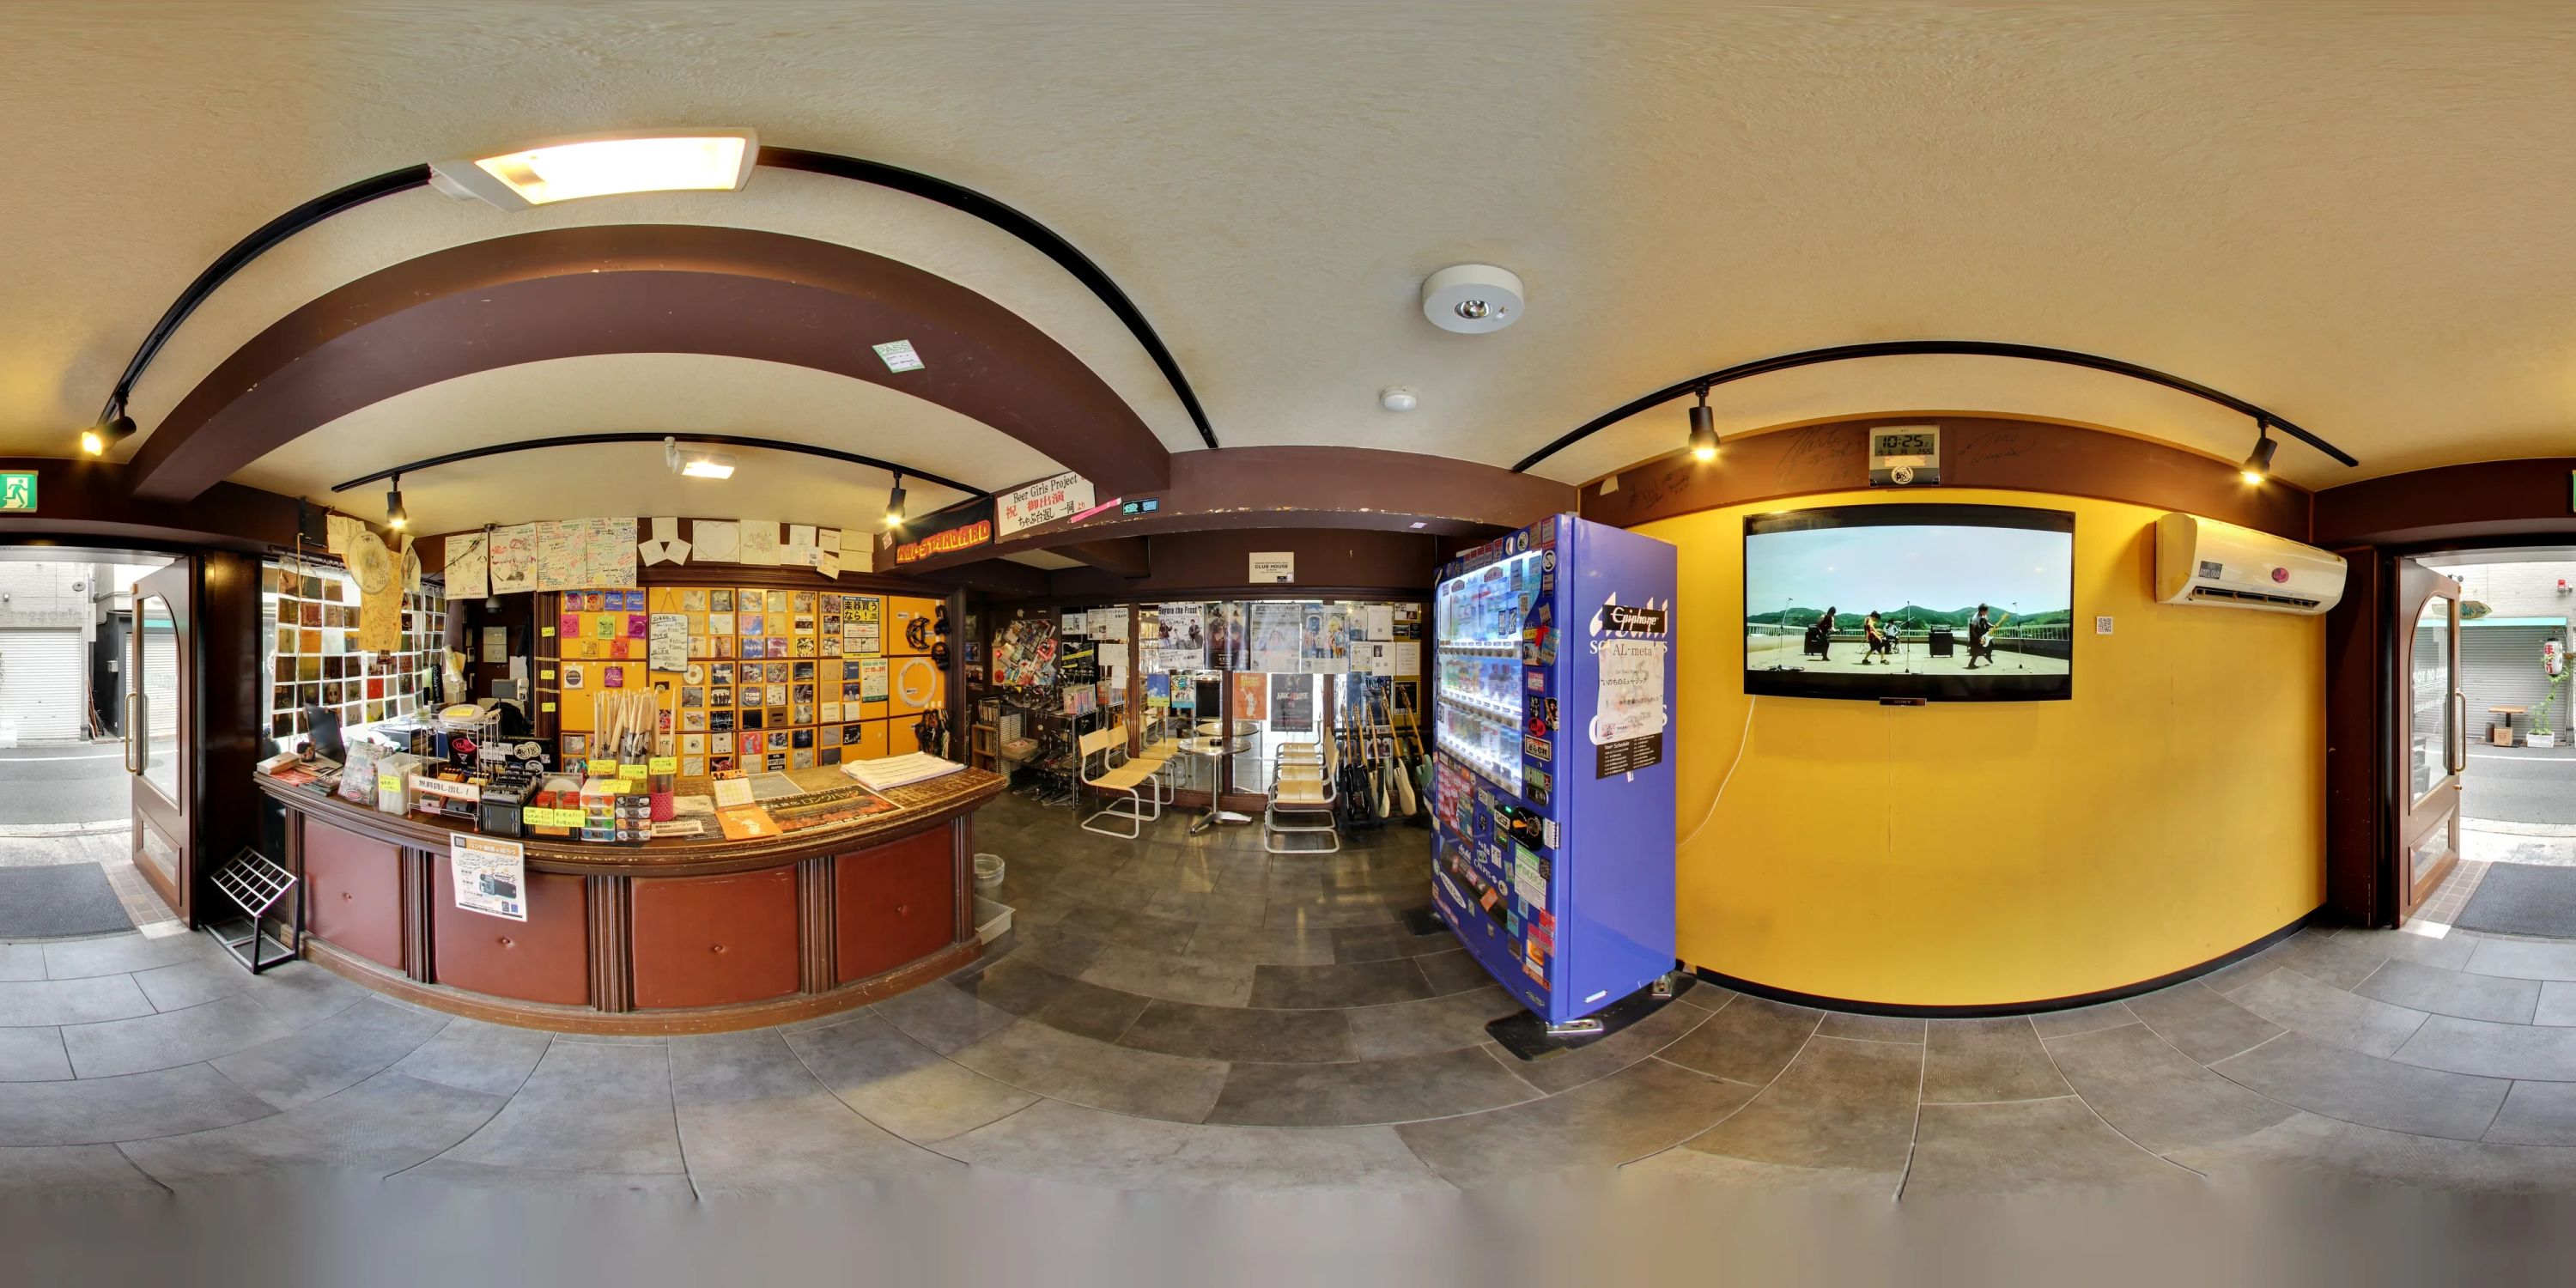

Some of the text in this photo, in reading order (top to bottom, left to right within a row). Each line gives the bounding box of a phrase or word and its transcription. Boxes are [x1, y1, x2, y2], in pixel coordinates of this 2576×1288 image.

[1883, 435, 1923, 447] 10:25
[1013, 474, 1078, 503] Beer Girls Project
[1005, 490, 1065, 519] 祝 御出演
[1018, 507, 1055, 528] ちゃぶ台返し
[844, 601, 878, 611] 楽器買う
[1158, 606, 1174, 616] Before
[1185, 605, 1198, 614] Frost
[1610, 607, 1657, 631] Epiphone
[1613, 643, 1653, 656] AL-meta
